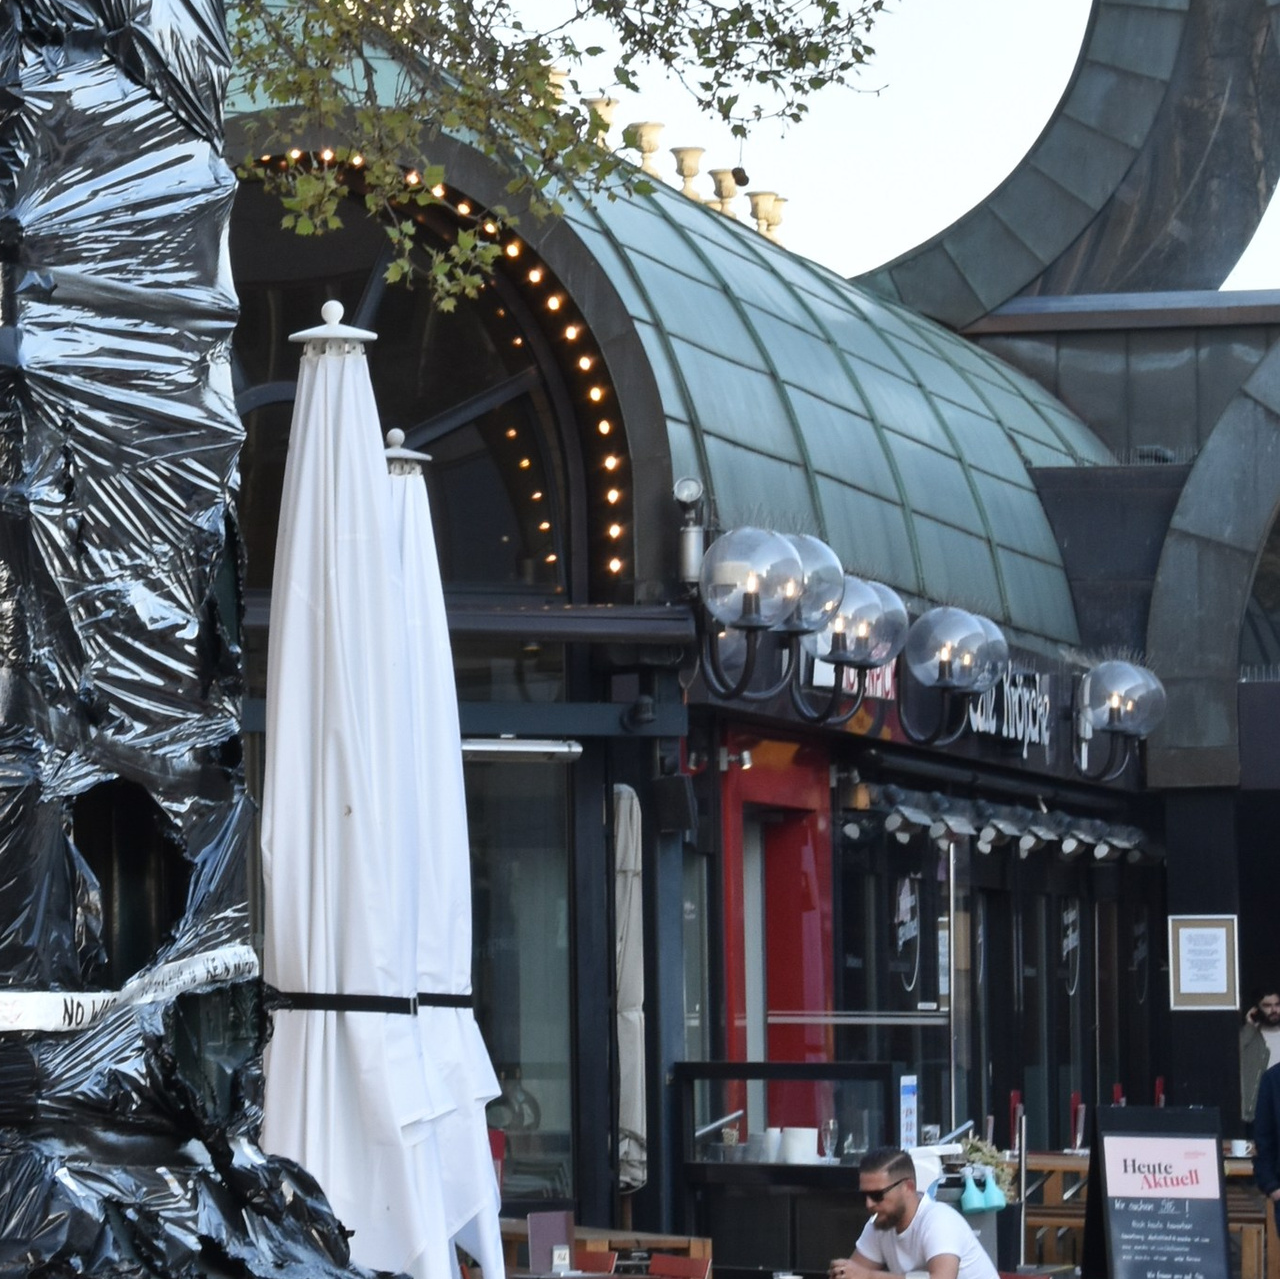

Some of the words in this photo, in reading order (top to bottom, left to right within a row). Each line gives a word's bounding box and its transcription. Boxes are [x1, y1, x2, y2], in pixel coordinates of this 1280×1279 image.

[1002, 659, 1050, 759] Kröpcke
[62, 997, 85, 1027] NO
[1123, 1158, 1173, 1175] Heute
[1141, 1170, 1200, 1190] Aktuell
